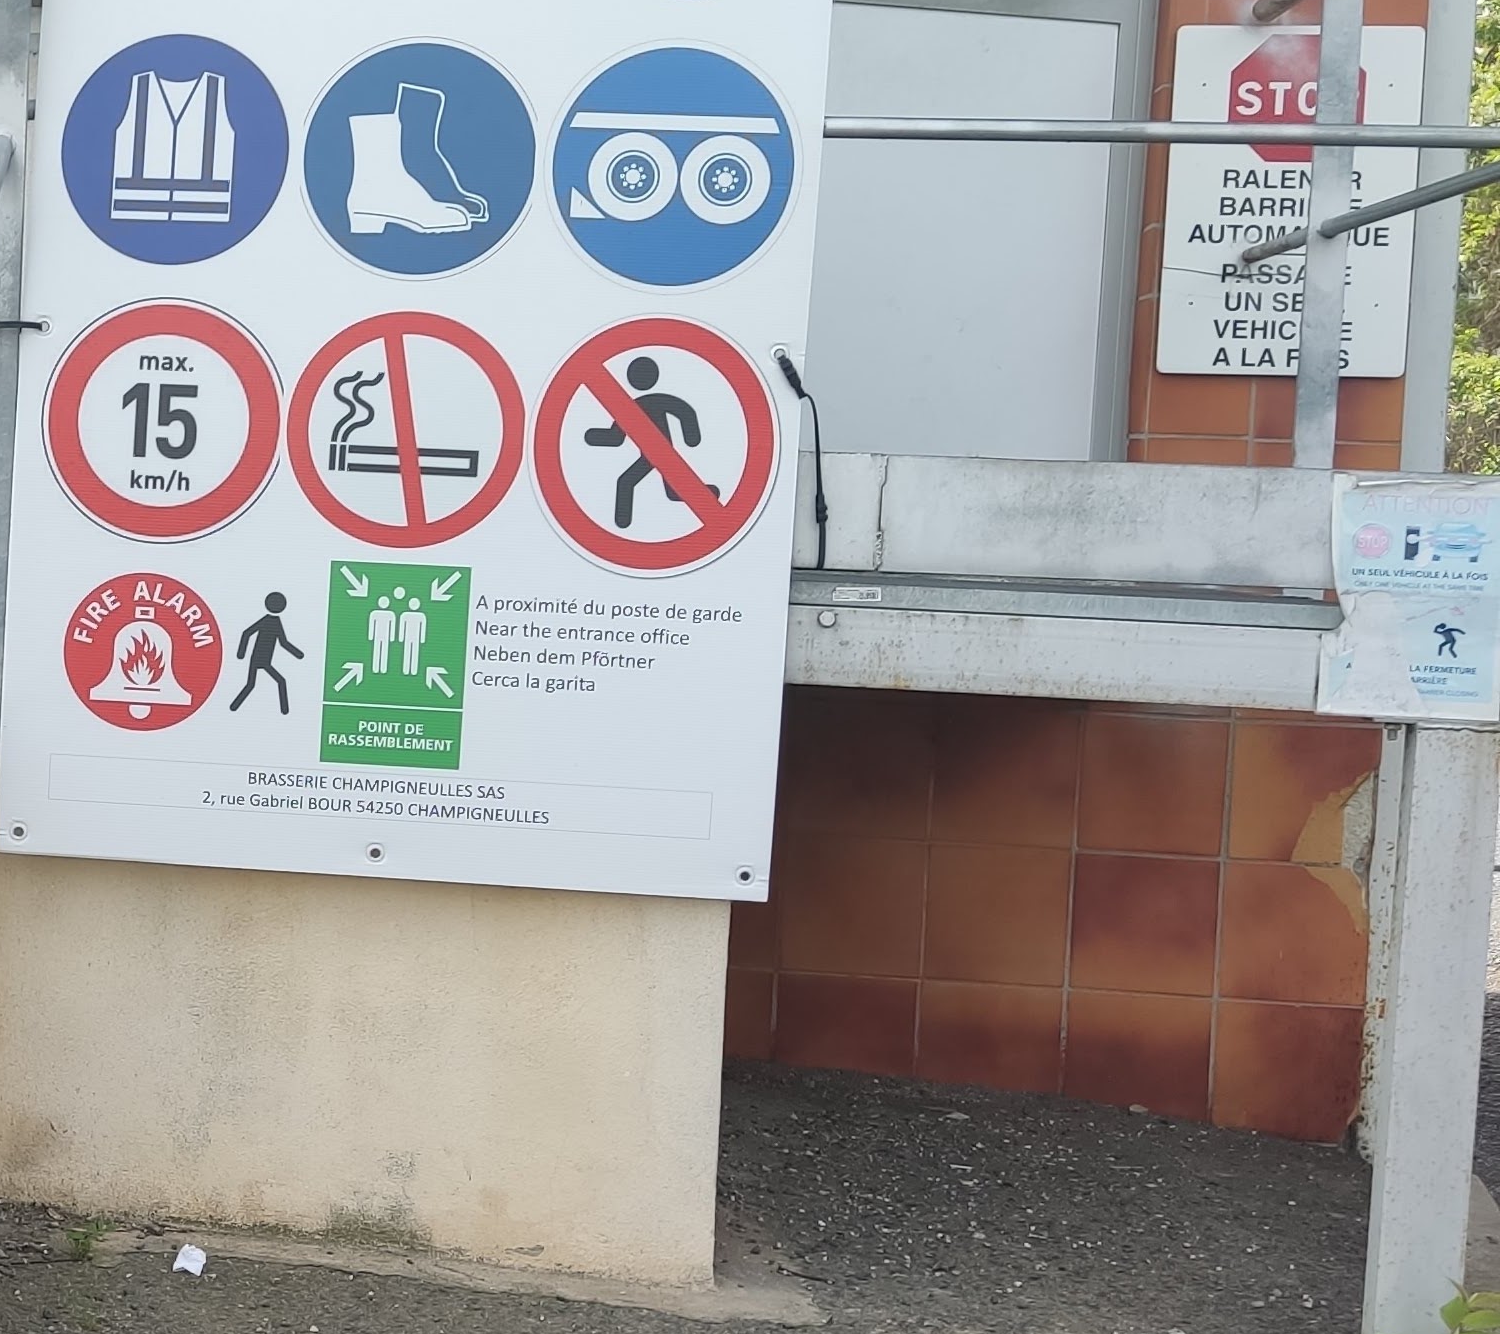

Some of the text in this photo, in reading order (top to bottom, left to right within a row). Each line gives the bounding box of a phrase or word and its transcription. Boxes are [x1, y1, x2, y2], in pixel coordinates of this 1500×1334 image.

[1235, 81, 1360, 116] STO
[1222, 169, 1362, 190] RALENR
[1219, 196, 1362, 217] BARRI
[1188, 224, 1390, 247] AUTOMAUE
[1220, 263, 1352, 286] PASSA
[1224, 292, 1262, 312] UN
[1213, 319, 1353, 342] VEHICE
[139, 354, 194, 372] max.
[1212, 347, 1350, 369] A LA FS
[122, 382, 198, 460] 15
[130, 469, 190, 492] km/h
[1362, 494, 1492, 516] ATTENTION
[1358, 534, 1387, 549] STOP
[1352, 568, 1365, 576] UN
[1368, 568, 1391, 577] SEUL
[1393, 569, 1440, 579] VÉHICULE
[1452, 571, 1463, 580] LA
[1466, 571, 1489, 581] FOIS
[73, 580, 215, 648] FIRE ALARM
[476, 595, 742, 624] A proximité du poste de garde
[475, 620, 690, 646] Near the entrance office
[474, 646, 531, 664] Neben
[536, 647, 575, 666] dem
[1409, 665, 1420, 673] LA
[1424, 665, 1477, 675] FERMETURE
[472, 671, 596, 694] Cerca la garita
[358, 720, 424, 736] POINT DE
[327, 733, 454, 753] RASSEMBLEMENT
[248, 771, 506, 800] BRASSERIE CHAMPIGNEULLES SAS
[202, 791, 550, 825] 2, rue Gabriel BOUR 54250 CHAMPIGNEULLES
